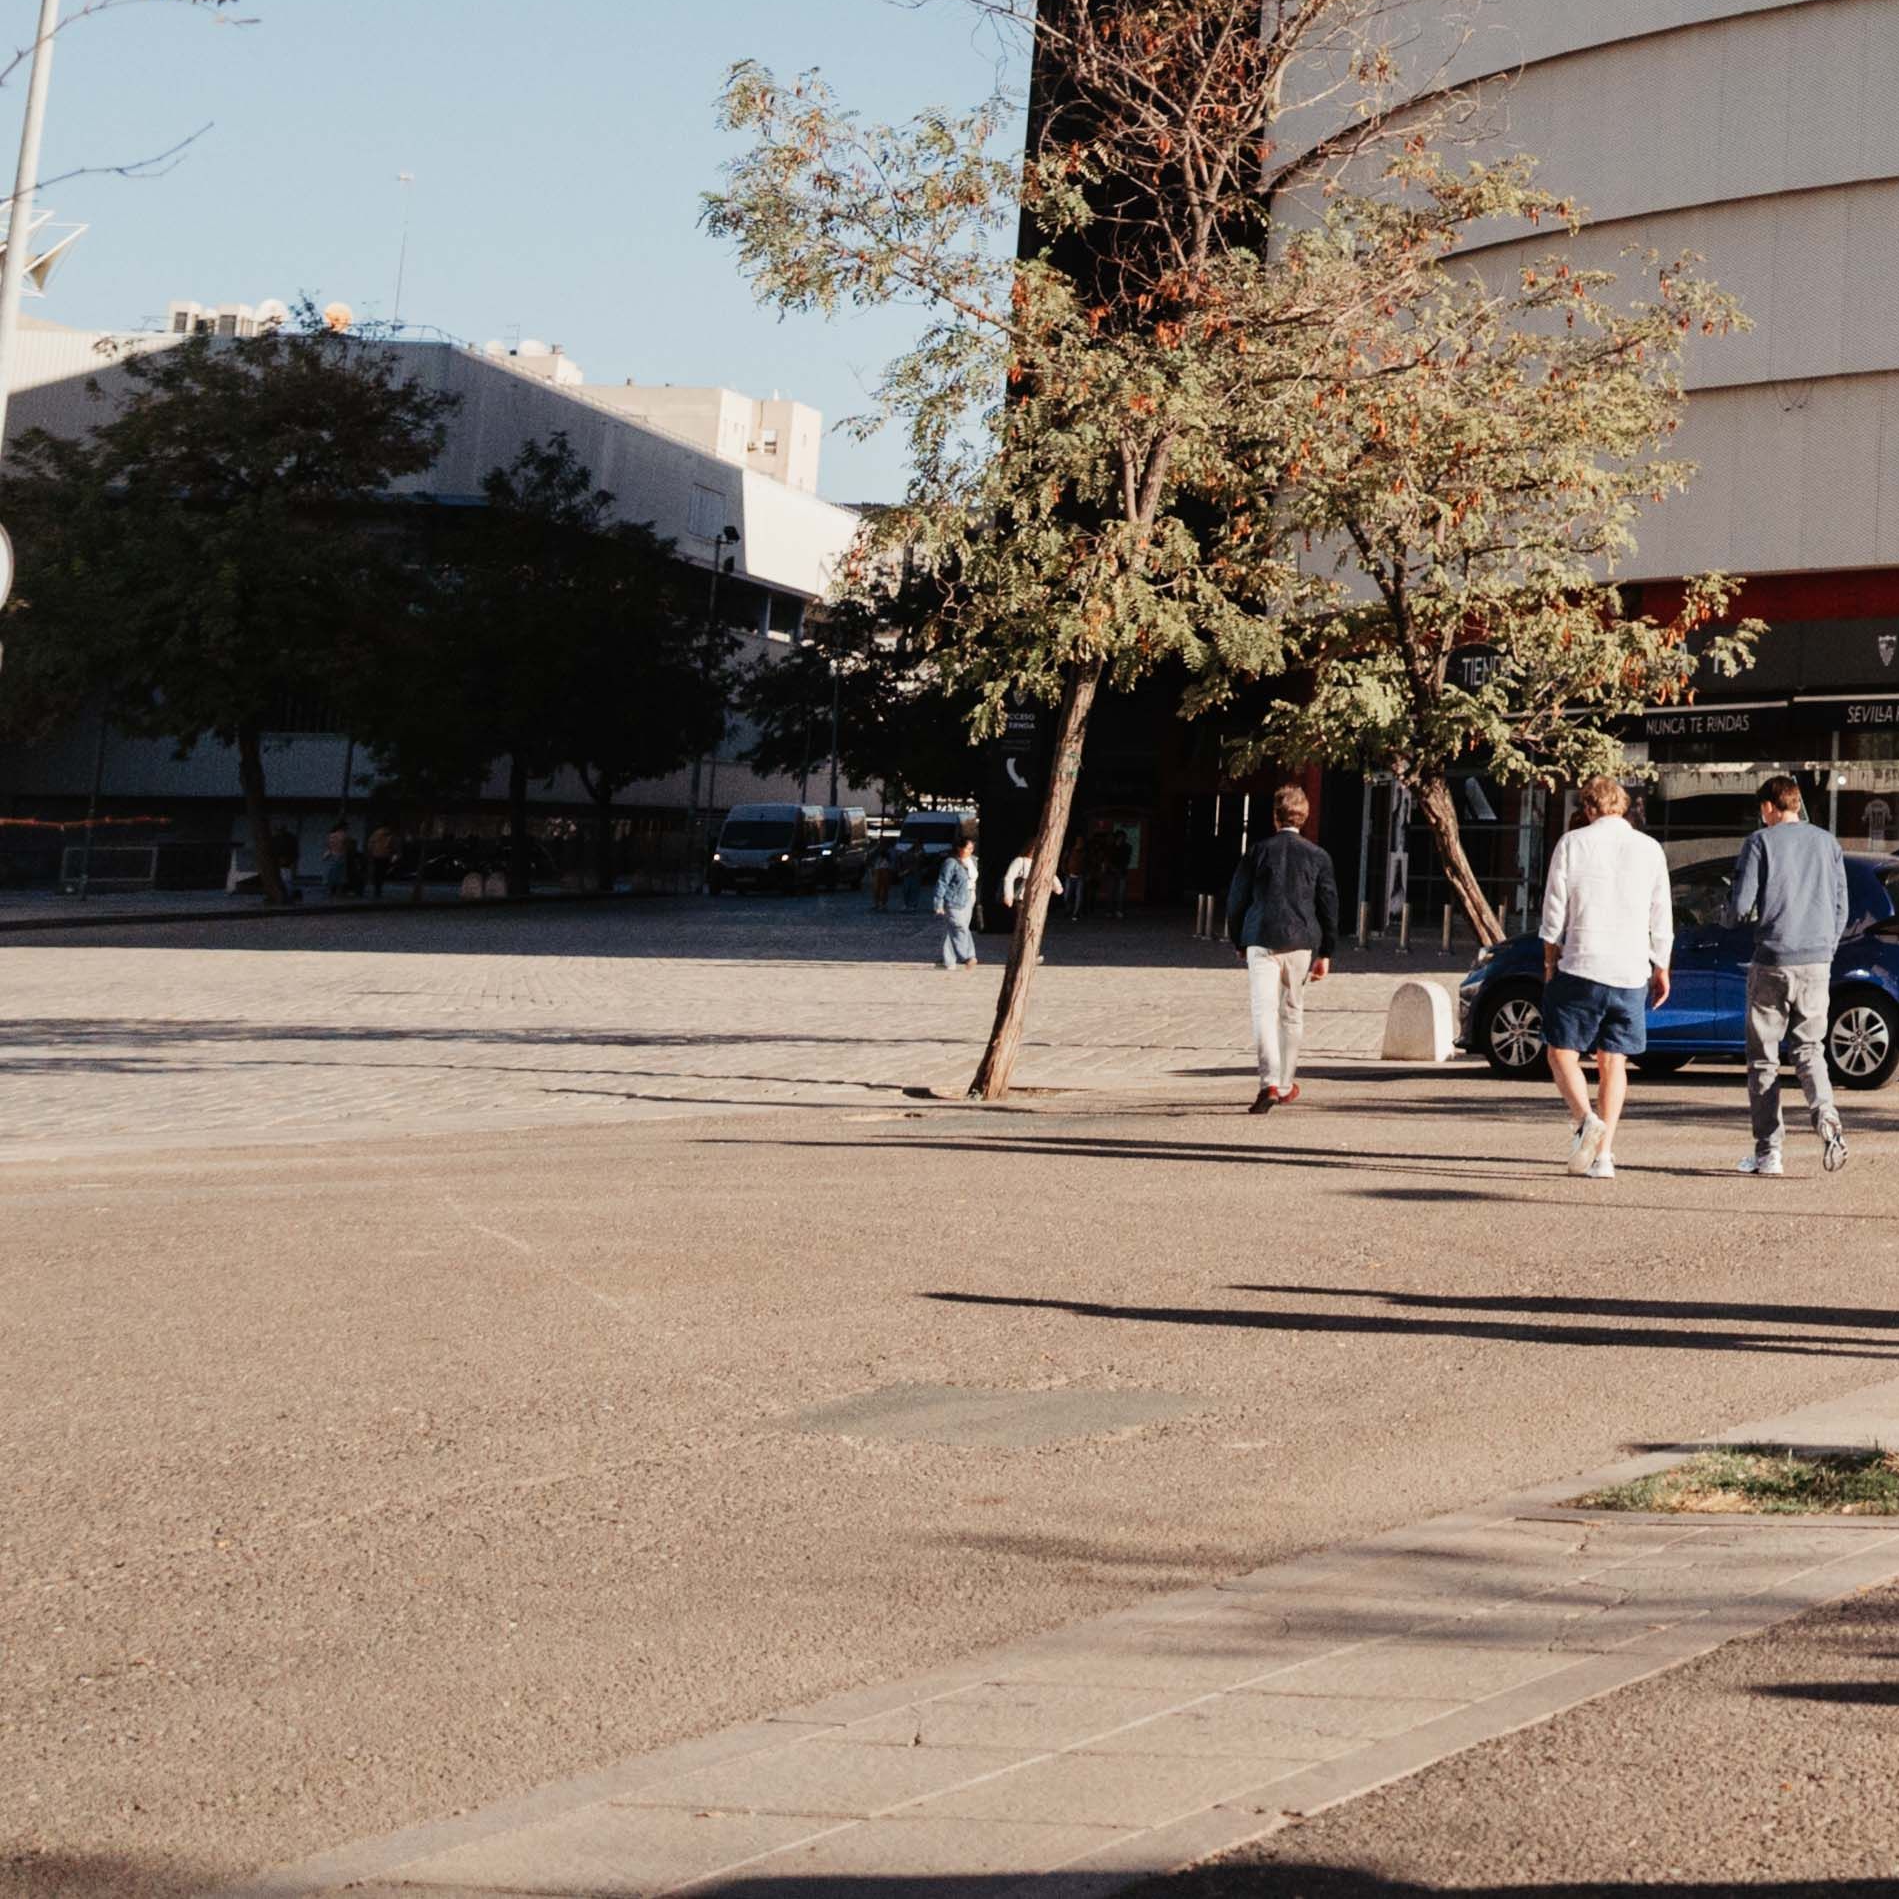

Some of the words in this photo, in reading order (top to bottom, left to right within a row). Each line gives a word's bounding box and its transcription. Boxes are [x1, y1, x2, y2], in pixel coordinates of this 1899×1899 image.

[1461, 655, 1511, 686] TIEND
[1008, 713, 1035, 721] CCESO
[1646, 717, 1686, 735] NUNCA
[1690, 717, 1704, 732] TE
[1706, 714, 1749, 732] RINDAS
[1847, 705, 1893, 724] SEVILLA
